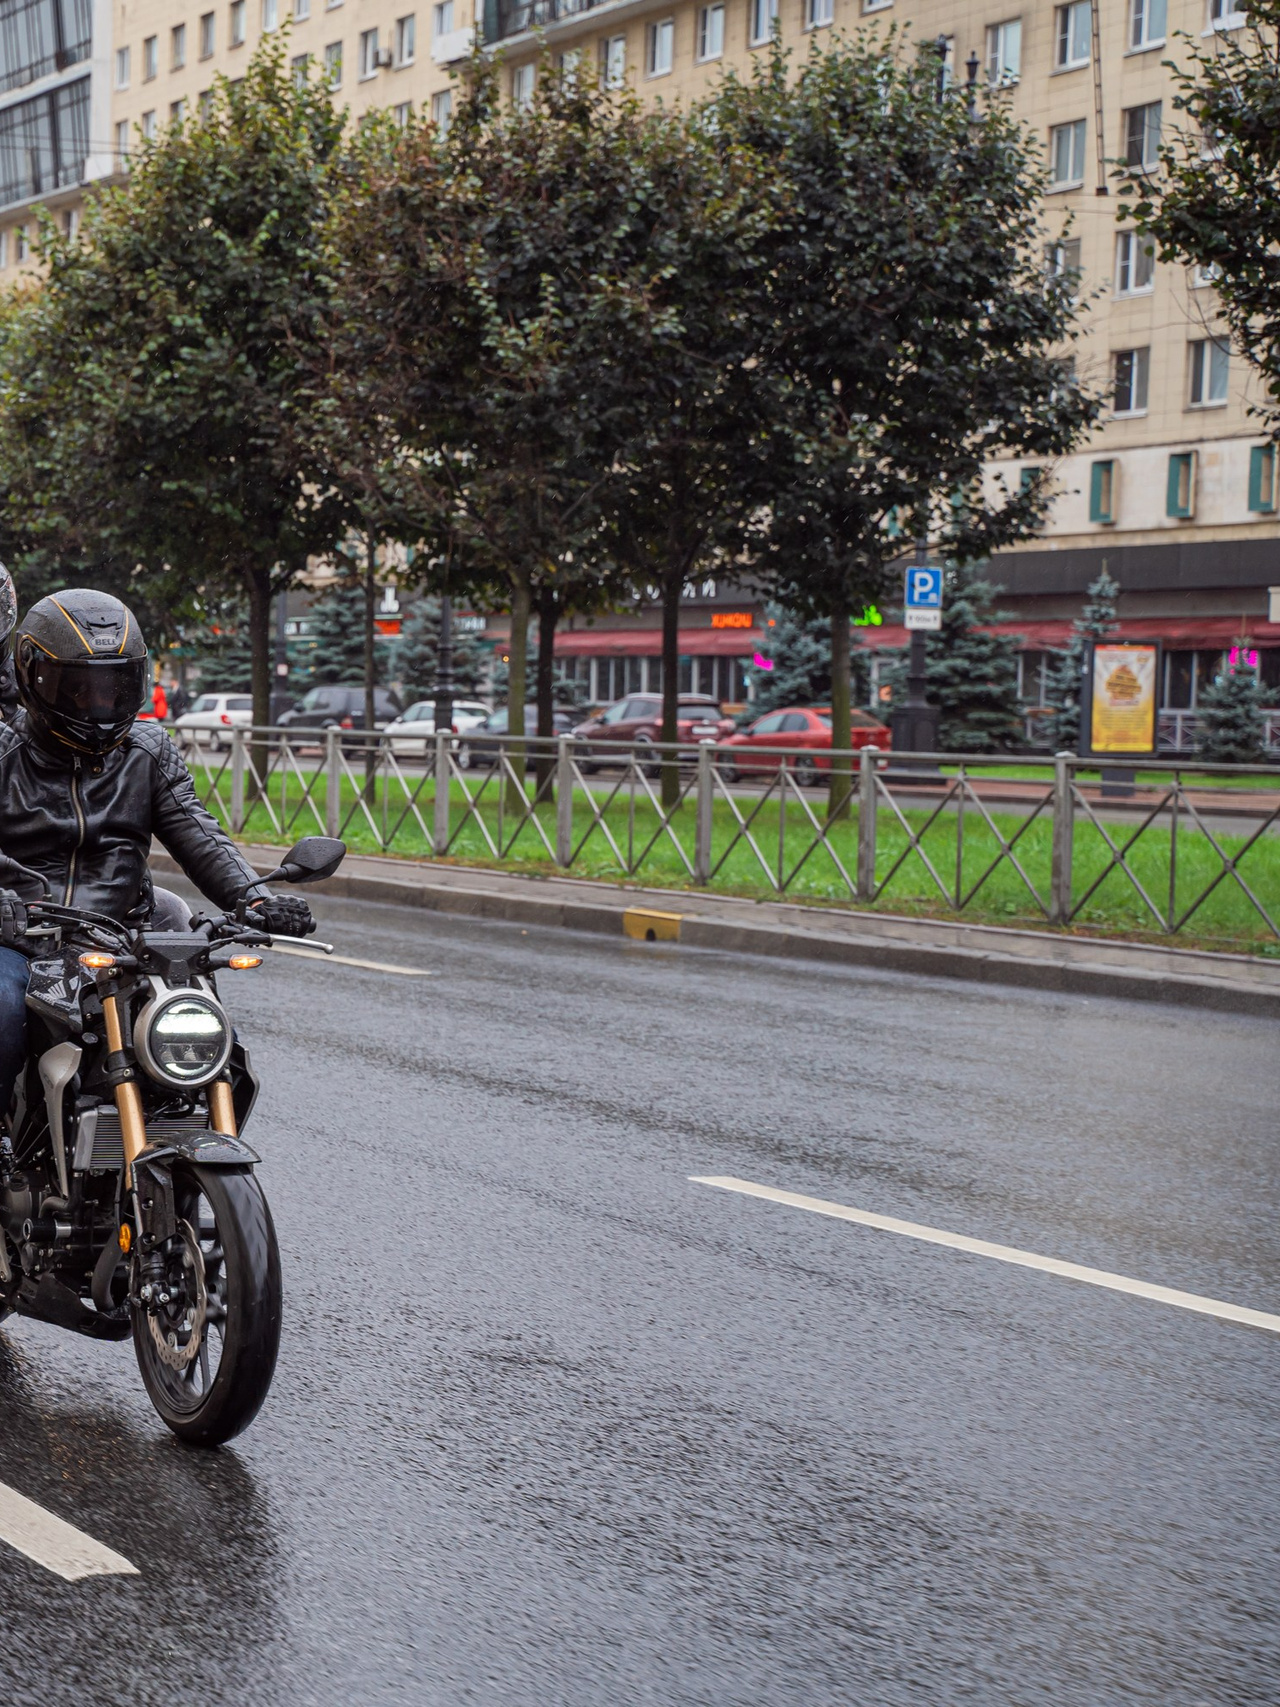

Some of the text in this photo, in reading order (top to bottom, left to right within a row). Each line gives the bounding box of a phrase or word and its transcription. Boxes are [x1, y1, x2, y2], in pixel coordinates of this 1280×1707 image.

[913, 571, 934, 603] P
[94, 638, 117, 646] BELL
[30, 990, 56, 1006] HONDA
